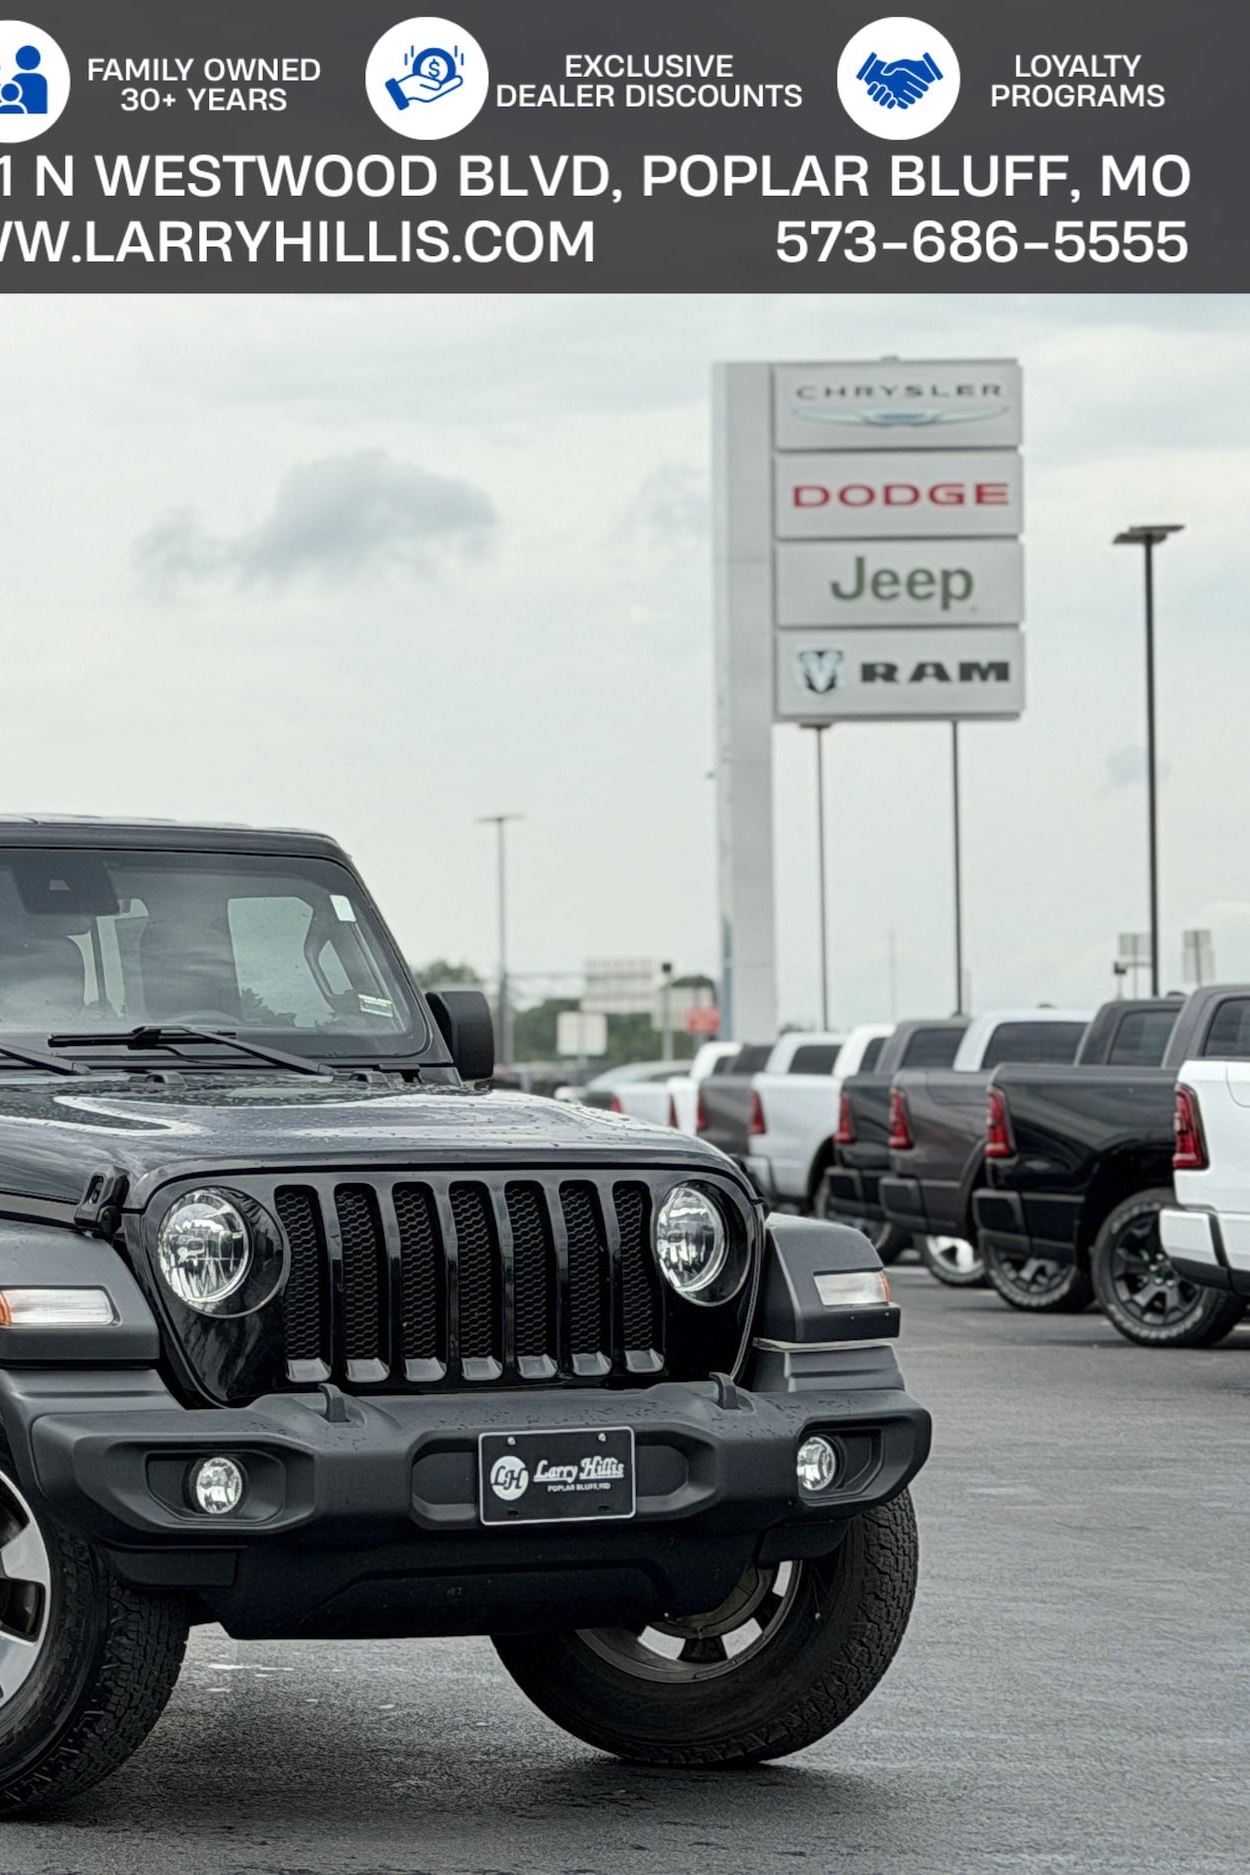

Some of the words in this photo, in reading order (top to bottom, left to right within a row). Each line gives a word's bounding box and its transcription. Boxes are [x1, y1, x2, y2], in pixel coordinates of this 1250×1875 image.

[795, 383, 1002, 400] CHRYSLER
[792, 483, 1010, 508] DODGE
[830, 556, 974, 611] Jeep
[860, 661, 1011, 684] RAM
[533, 1459, 578, 1483] Larry
[579, 1456, 625, 1480] Hillis
